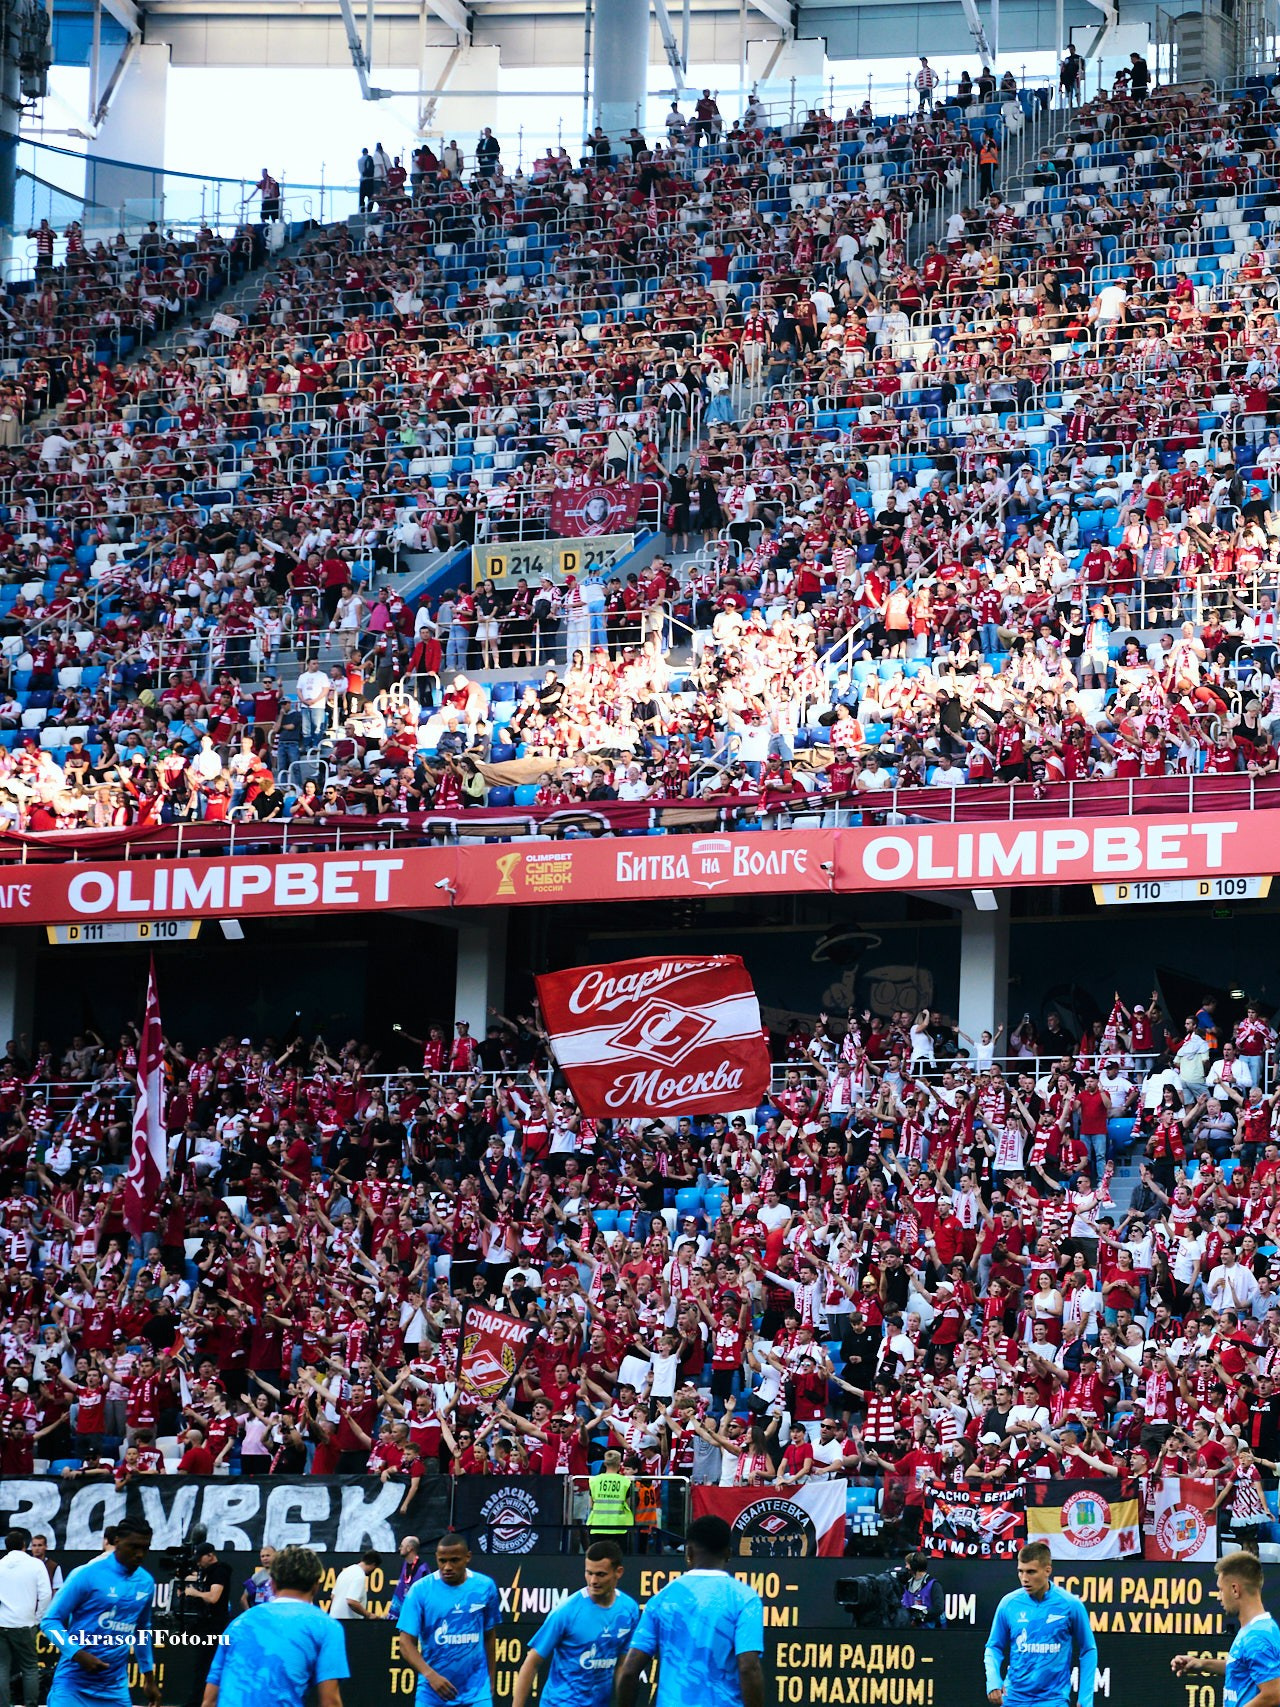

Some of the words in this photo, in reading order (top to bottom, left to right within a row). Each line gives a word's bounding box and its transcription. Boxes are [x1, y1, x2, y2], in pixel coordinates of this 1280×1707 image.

[491, 558, 502, 575] D
[511, 556, 543, 575] 214
[564, 553, 576, 570] D
[525, 853, 573, 862] OLIMPBET
[862, 821, 1238, 881] OLIMPBET
[525, 861, 572, 874] СУПЕР
[68, 858, 403, 914] OLIMPBET
[525, 873, 572, 885] КУБОК
[1199, 882, 1209, 896] D
[1215, 879, 1247, 896] 109
[533, 885, 563, 893] РОССИИ
[1118, 885, 1128, 899] D
[1134, 882, 1161, 899] 110
[70, 926, 79, 940] D
[84, 925, 103, 940] 111
[140, 923, 149, 936] D
[154, 921, 178, 937] 110
[605, 1066, 743, 1108] Москва
[465, 1307, 534, 1344] СПАРТАК
[599, 1480, 621, 1492] 16780
[642, 1484, 657, 1504] 69
[1063, 1491, 1108, 1513] КРАСНО-БЕЛОЕ
[735, 1500, 811, 1531] ИВАНТЕЕВКА
[1185, 1504, 1207, 1555] КРАСНО-БЕЛАЯ
[924, 1536, 1018, 1555] КИМОВСК
[1072, 1537, 1101, 1548] ТУШИНО
[1121, 1578, 1203, 1608] РАДИО
[776, 1642, 833, 1669] ЕСЛИ
[840, 1644, 915, 1674] РАДИО
[389, 1668, 416, 1694] ТО
[775, 1675, 803, 1703] ТО
[810, 1676, 934, 1706] MAXIMUM!
